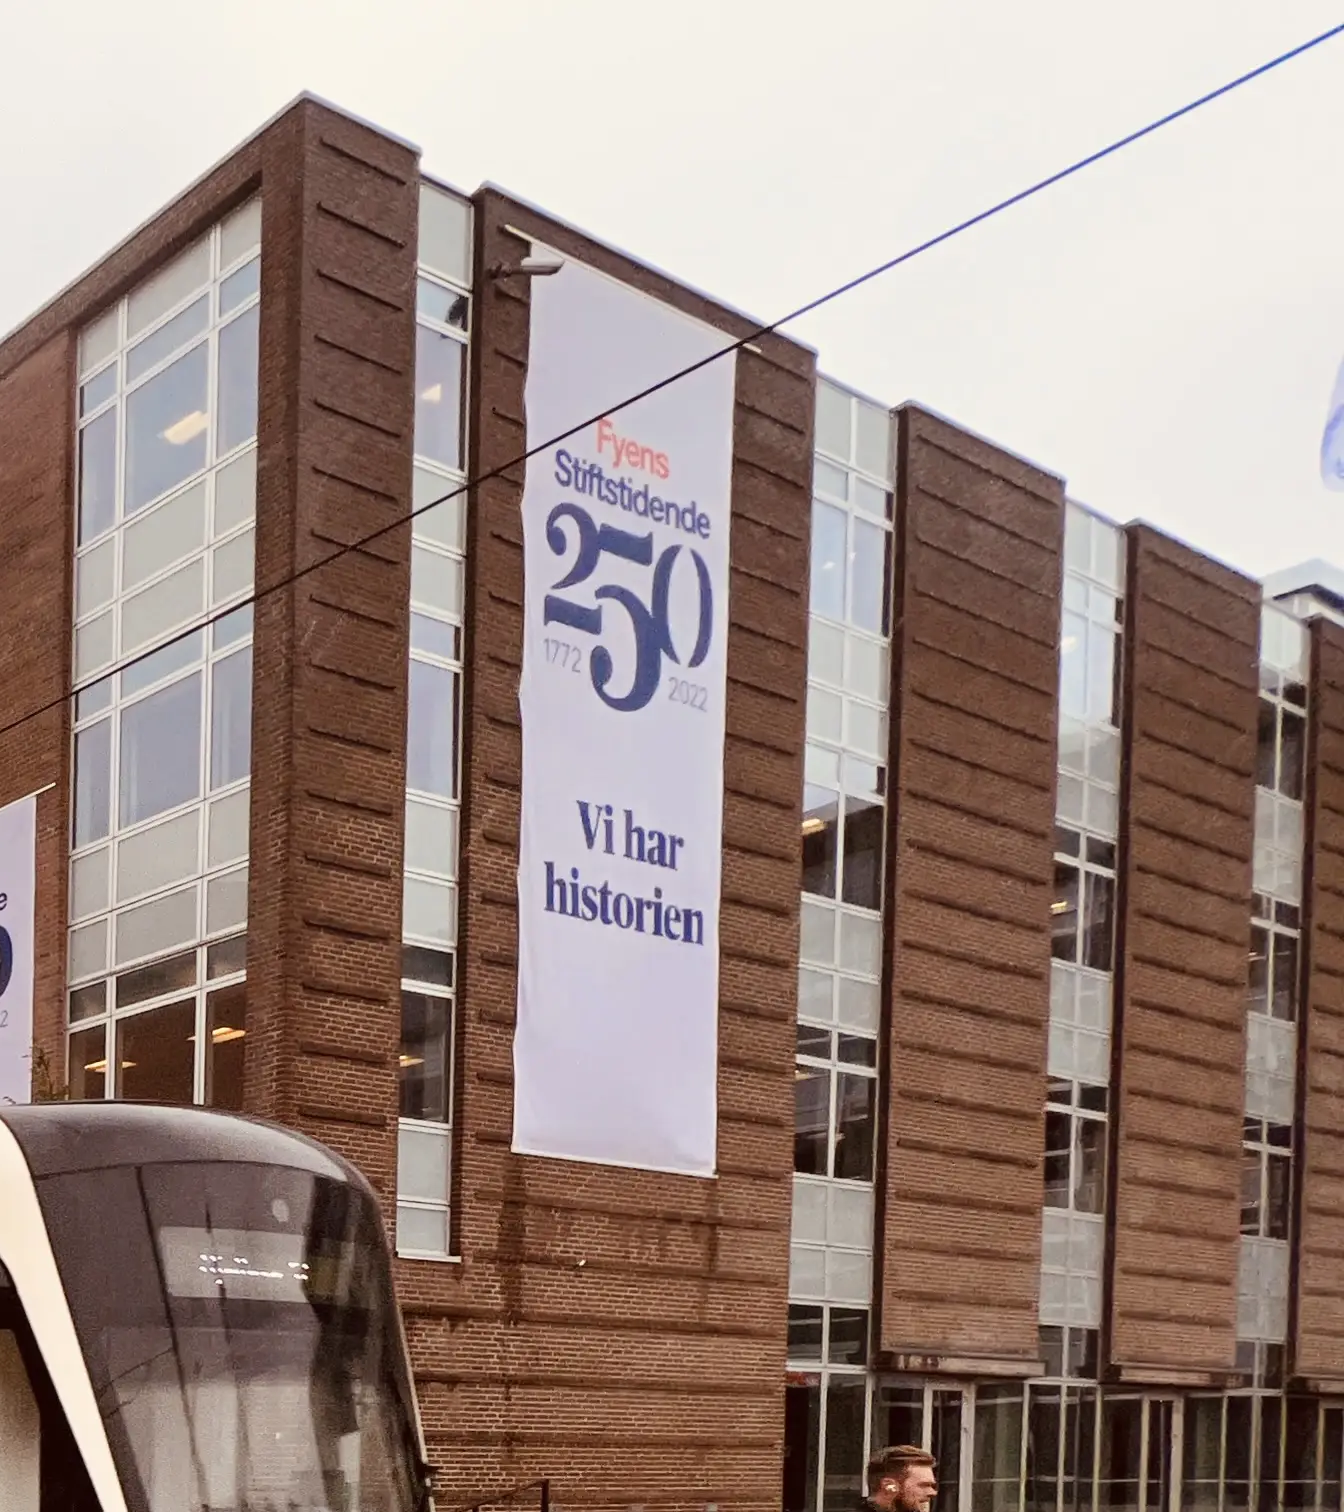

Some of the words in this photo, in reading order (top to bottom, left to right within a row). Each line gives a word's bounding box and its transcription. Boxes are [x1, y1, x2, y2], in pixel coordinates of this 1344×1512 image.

[596, 417, 670, 479] Fyens
[554, 448, 711, 540] Stiftstidende
[543, 502, 713, 712] 250
[542, 637, 582, 673] 1772
[667, 676, 708, 713] 2022
[576, 799, 615, 855] Vi
[623, 808, 685, 871] har
[543, 860, 704, 946] historien
